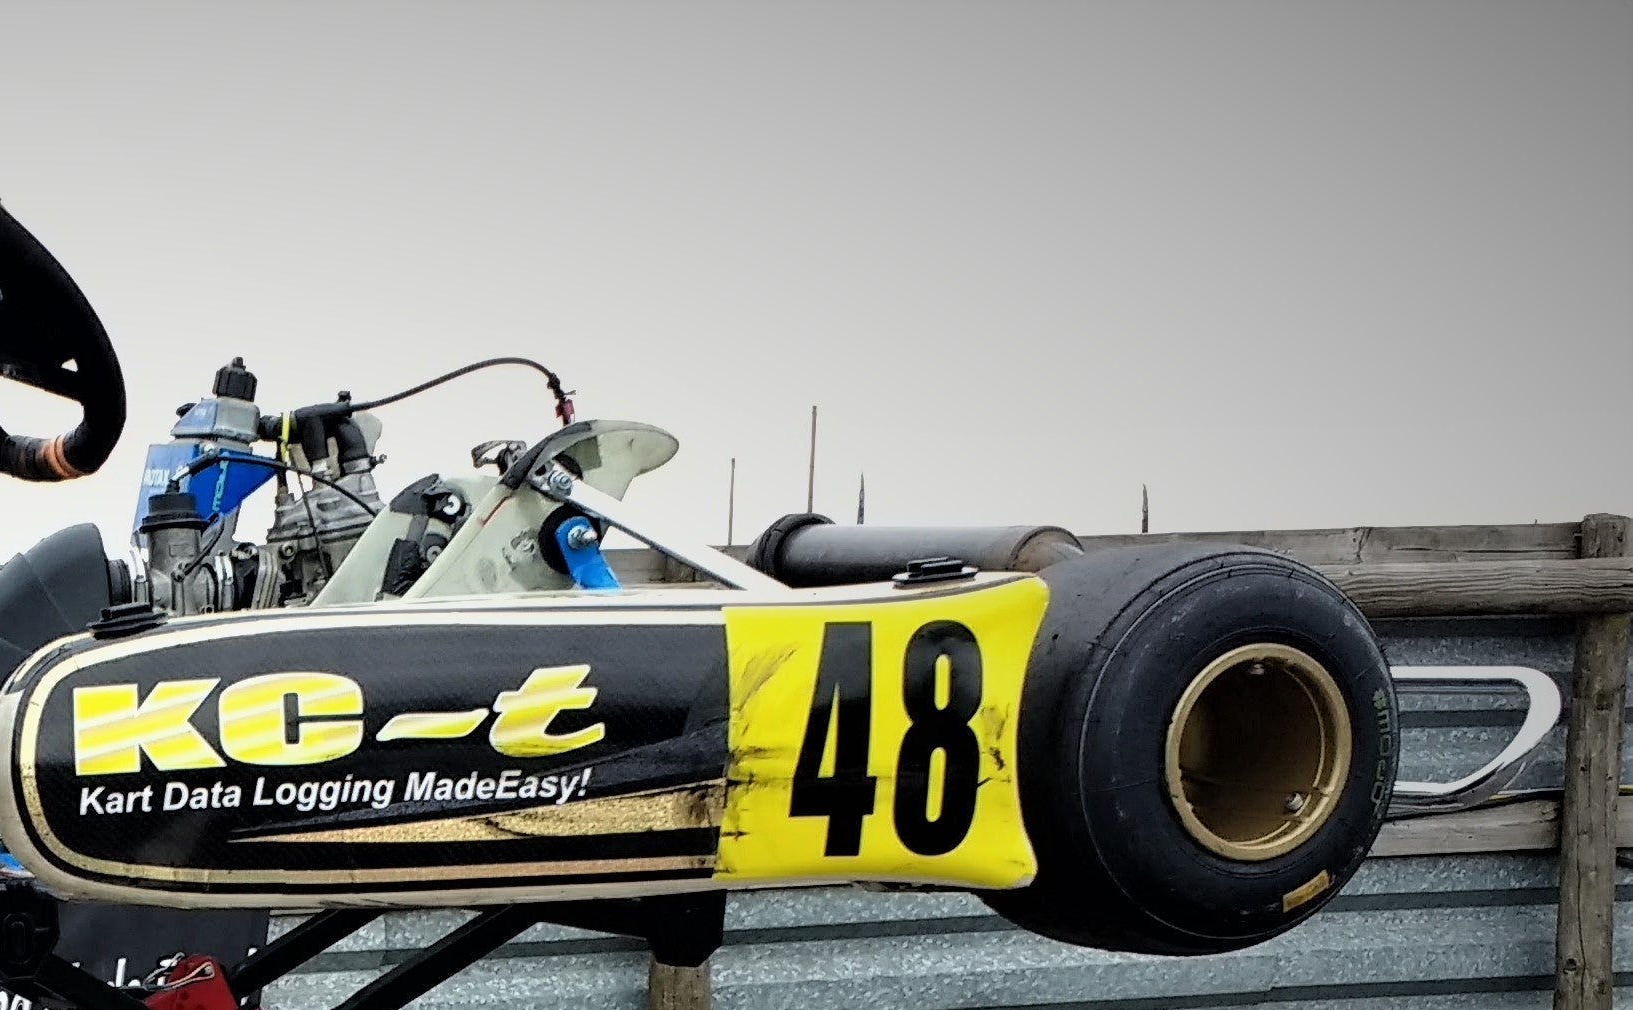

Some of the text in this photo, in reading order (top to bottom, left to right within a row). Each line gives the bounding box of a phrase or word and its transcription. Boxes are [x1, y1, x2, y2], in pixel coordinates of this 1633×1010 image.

[72, 664, 606, 775] KC-t
[790, 620, 983, 857] 48
[79, 767, 593, 815] Kart Data Logging MadeEasy!
